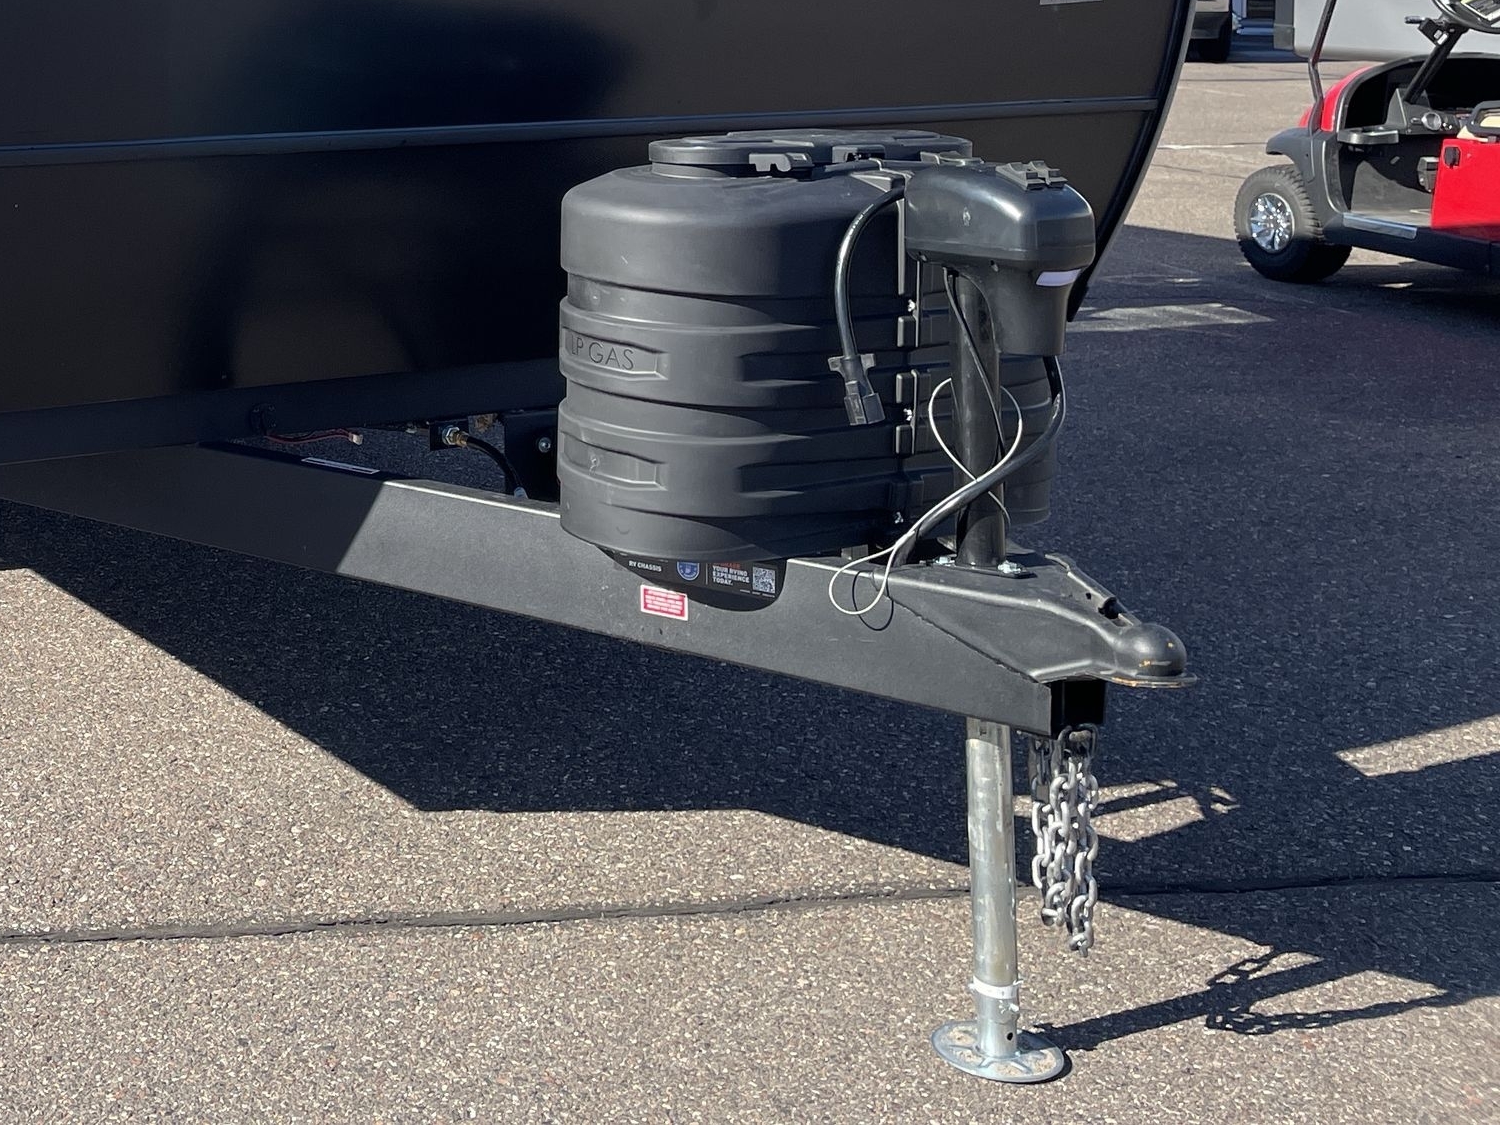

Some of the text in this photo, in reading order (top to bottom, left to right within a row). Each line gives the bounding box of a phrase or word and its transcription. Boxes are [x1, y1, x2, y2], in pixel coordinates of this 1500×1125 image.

[571, 335, 634, 371] LP GAS
[712, 571, 750, 584] EXPERIENCE
